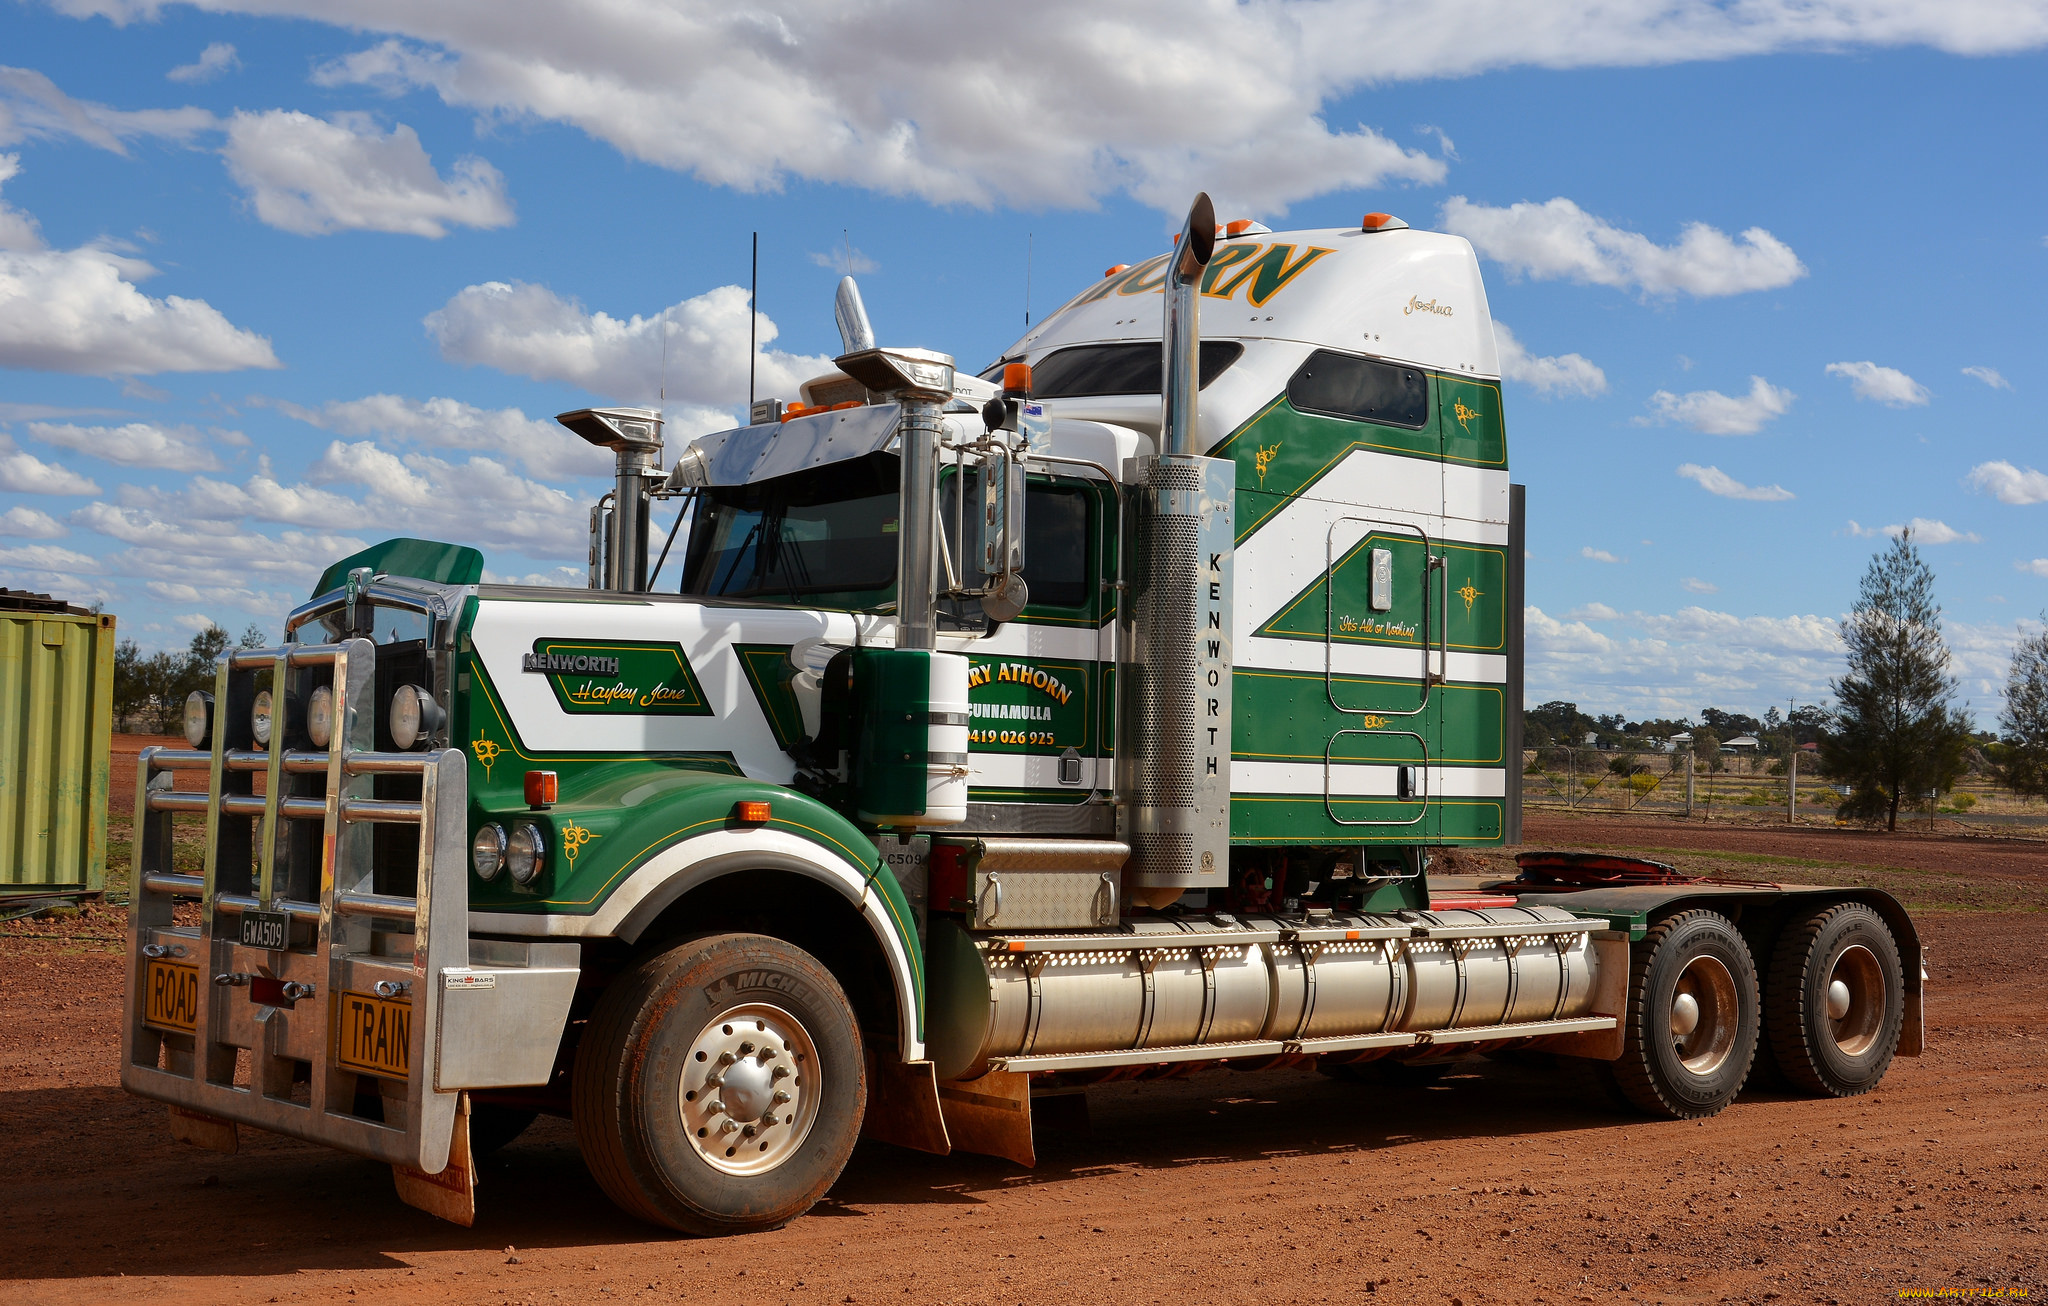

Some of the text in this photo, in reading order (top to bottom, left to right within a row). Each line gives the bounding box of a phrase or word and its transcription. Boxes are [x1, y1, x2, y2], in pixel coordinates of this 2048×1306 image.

[1403, 294, 1453, 316] Joshua
[1359, 617, 1375, 633] All
[1374, 623, 1385, 634] or
[523, 652, 619, 674] KENWORTH
[1206, 553, 1221, 775] KENWORTH
[572, 680, 686, 706] Hayley Jane
[968, 662, 1073, 705] RY ATHORN
[1000, 730, 1026, 745] 026
[1029, 731, 1055, 745] 925
[887, 853, 922, 866] C509
[243, 919, 282, 947] GWA509
[1680, 931, 1750, 977] TRIANGLE
[154, 966, 197, 1022] ROAD
[352, 1001, 411, 1069] TRAIN
